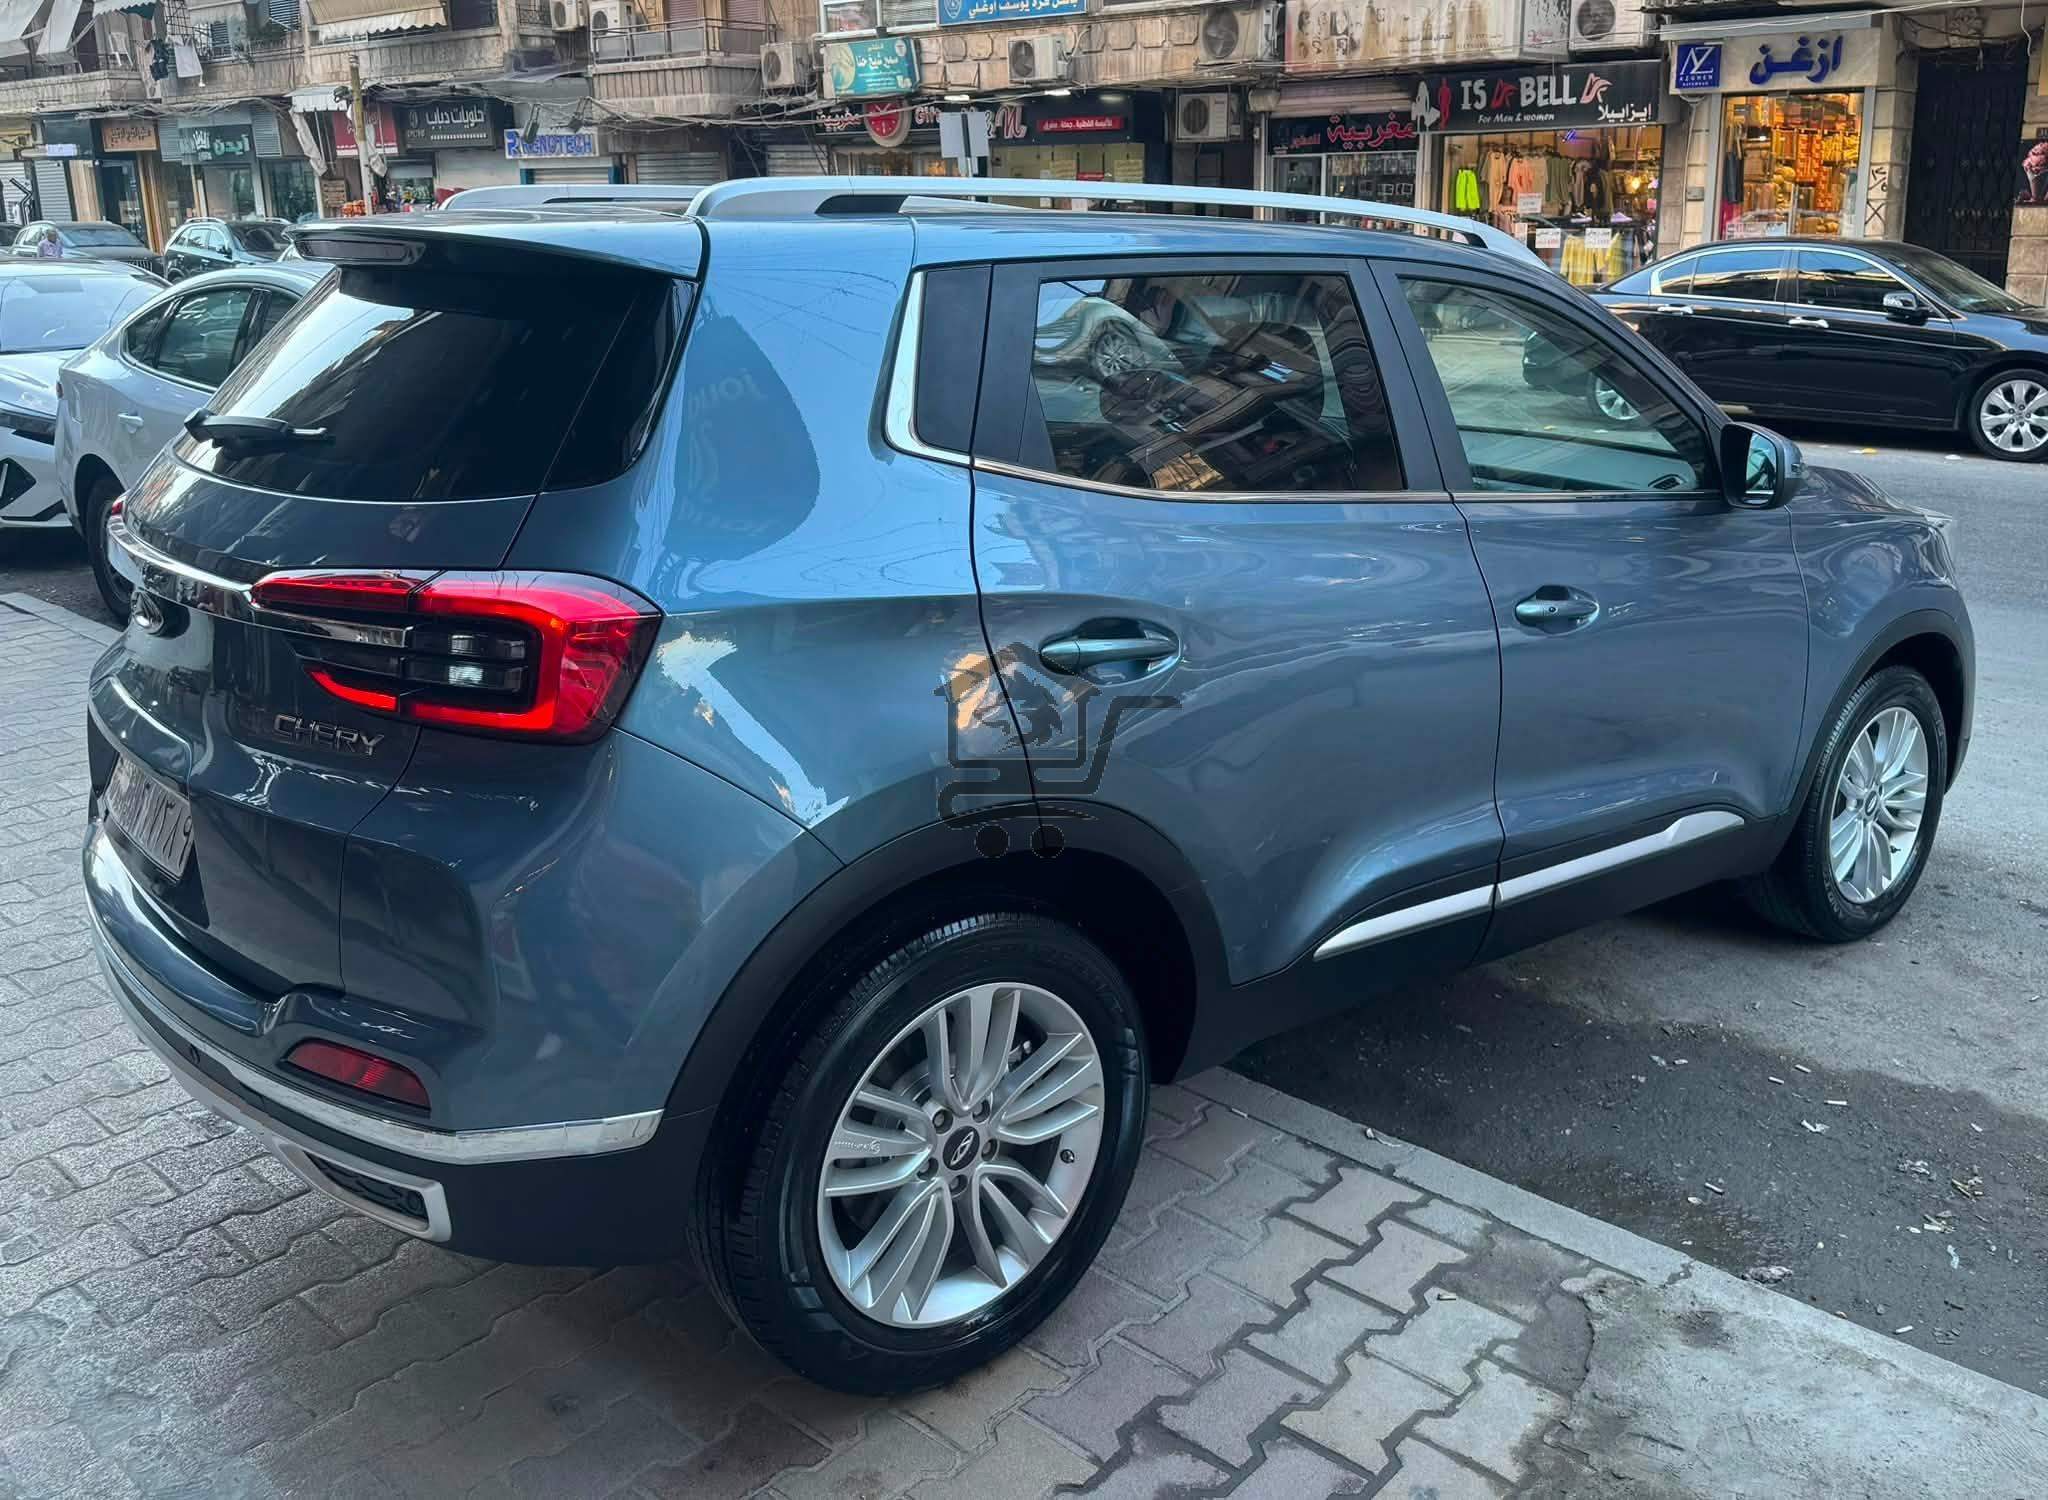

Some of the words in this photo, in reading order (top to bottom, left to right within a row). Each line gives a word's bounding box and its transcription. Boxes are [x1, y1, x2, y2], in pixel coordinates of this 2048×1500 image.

[425, 107, 450, 129] دباب
[451, 104, 485, 128] حلويات
[1494, 114, 1513, 122] Men
[273, 713, 386, 756] CHERY
